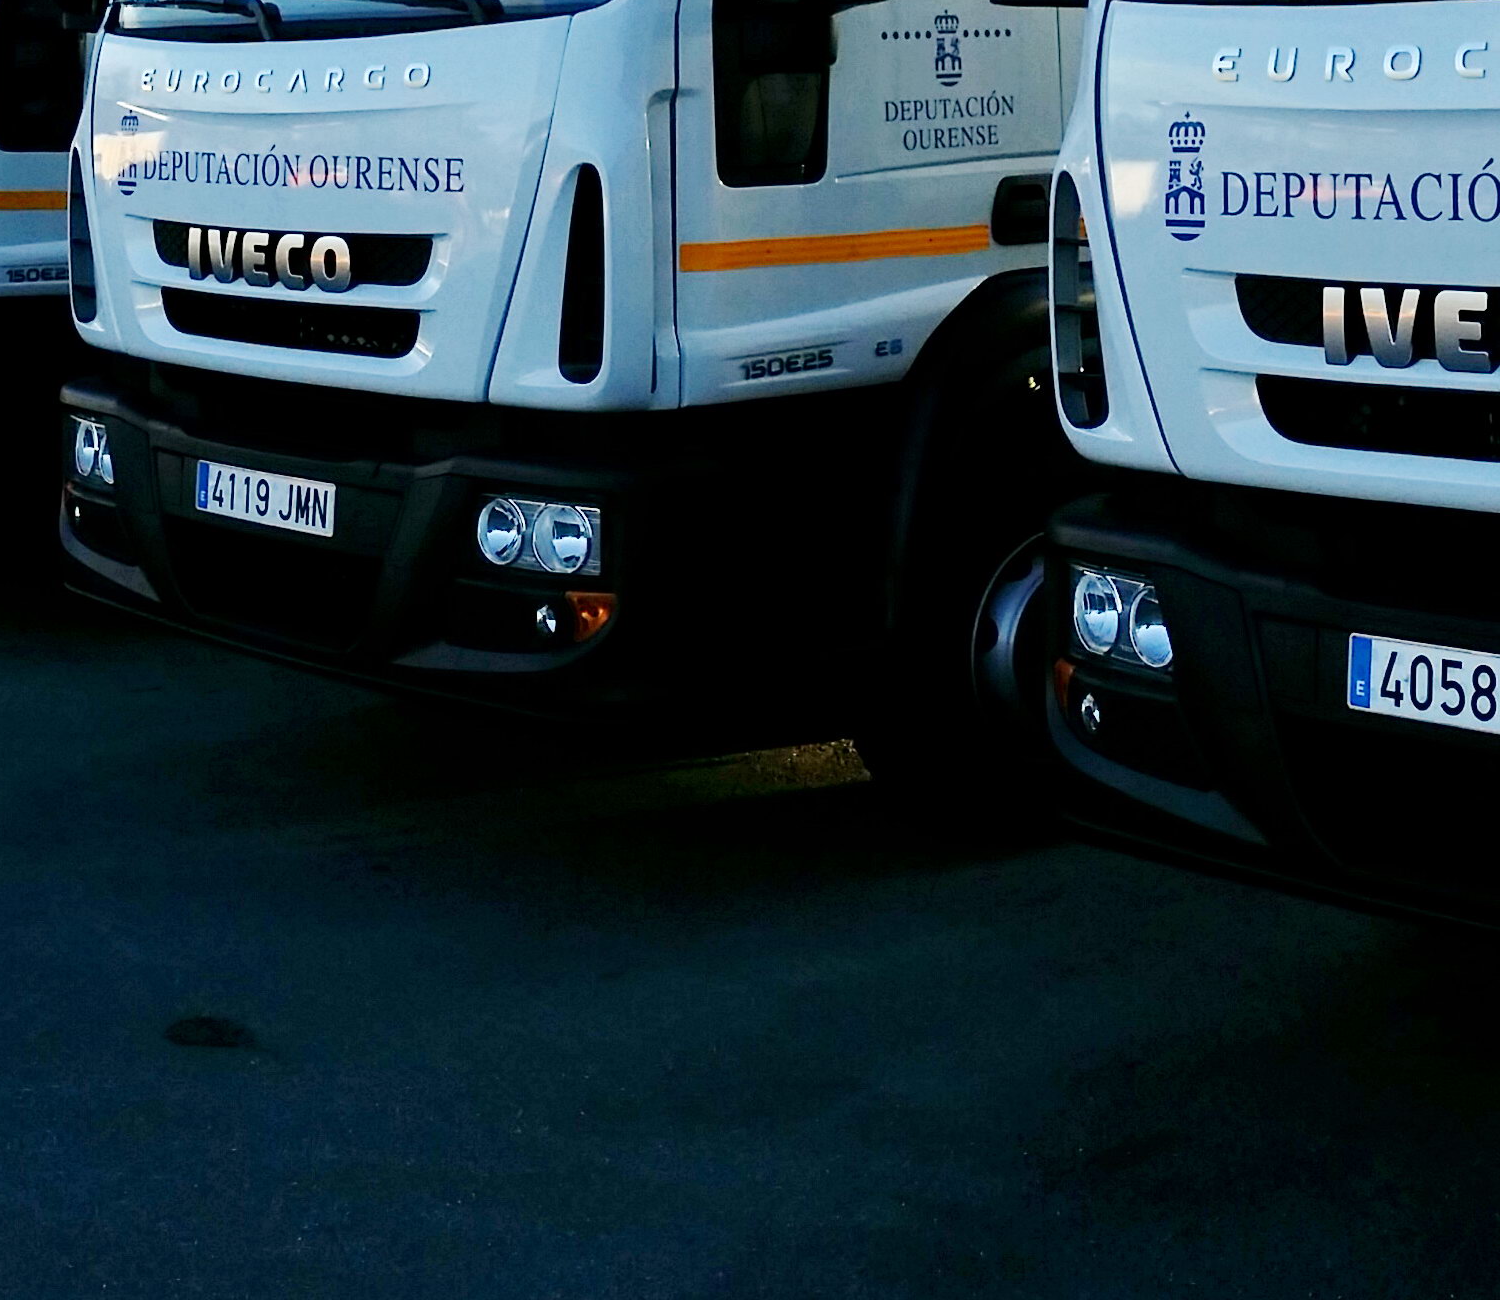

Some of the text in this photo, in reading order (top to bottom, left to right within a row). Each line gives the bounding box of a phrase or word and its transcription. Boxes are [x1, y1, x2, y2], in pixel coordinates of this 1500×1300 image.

[140, 62, 433, 94] EUROCARGO
[884, 90, 1014, 122] DEPUTACIÓN
[903, 124, 999, 151] OURENSE
[143, 144, 466, 194] DEPUTACIÓN OURENSE
[6, 267, 69, 283] 150E2
[187, 226, 353, 293] IVECO
[739, 349, 834, 381] 150E25
[212, 470, 329, 529] 4119 JMN
[1355, 680, 1366, 697] E
[1380, 651, 1498, 722] 4058
